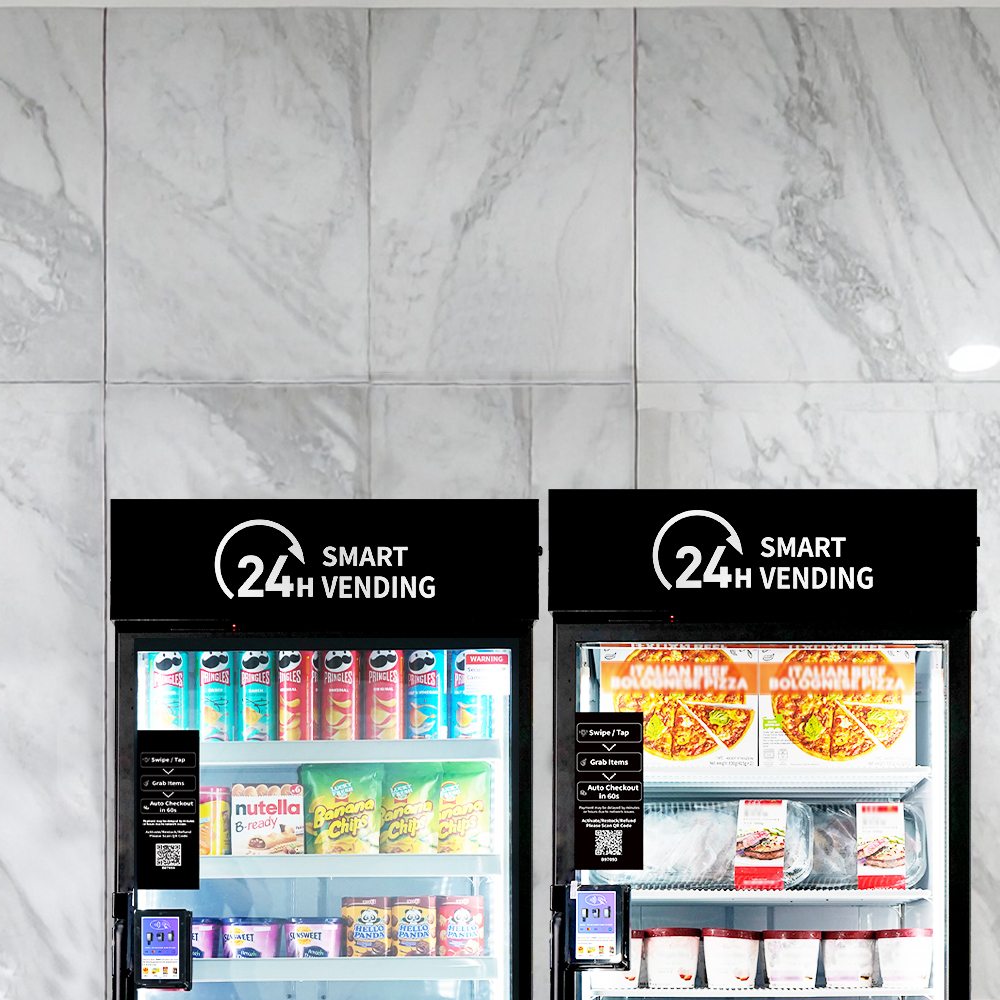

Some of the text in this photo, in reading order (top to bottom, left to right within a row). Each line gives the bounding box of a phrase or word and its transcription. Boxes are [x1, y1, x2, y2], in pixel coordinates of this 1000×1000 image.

[322, 546, 408, 567] SMART
[760, 536, 846, 558] SMART
[321, 576, 436, 599] VENDING
[759, 566, 874, 590] VENDING
[201, 670, 229, 684] PRINGLES
[242, 670, 270, 685] PRINGLES
[324, 671, 353, 684] PRINGLES
[369, 670, 398, 684] PRINGLES
[589, 729, 611, 737] Swipe
[236, 799, 300, 815] nutella
[314, 798, 375, 830] Banana
[235, 816, 278, 832] B-ready
[328, 814, 368, 839] Chips
[388, 815, 427, 840] Chips
[439, 815, 478, 840] Chips
